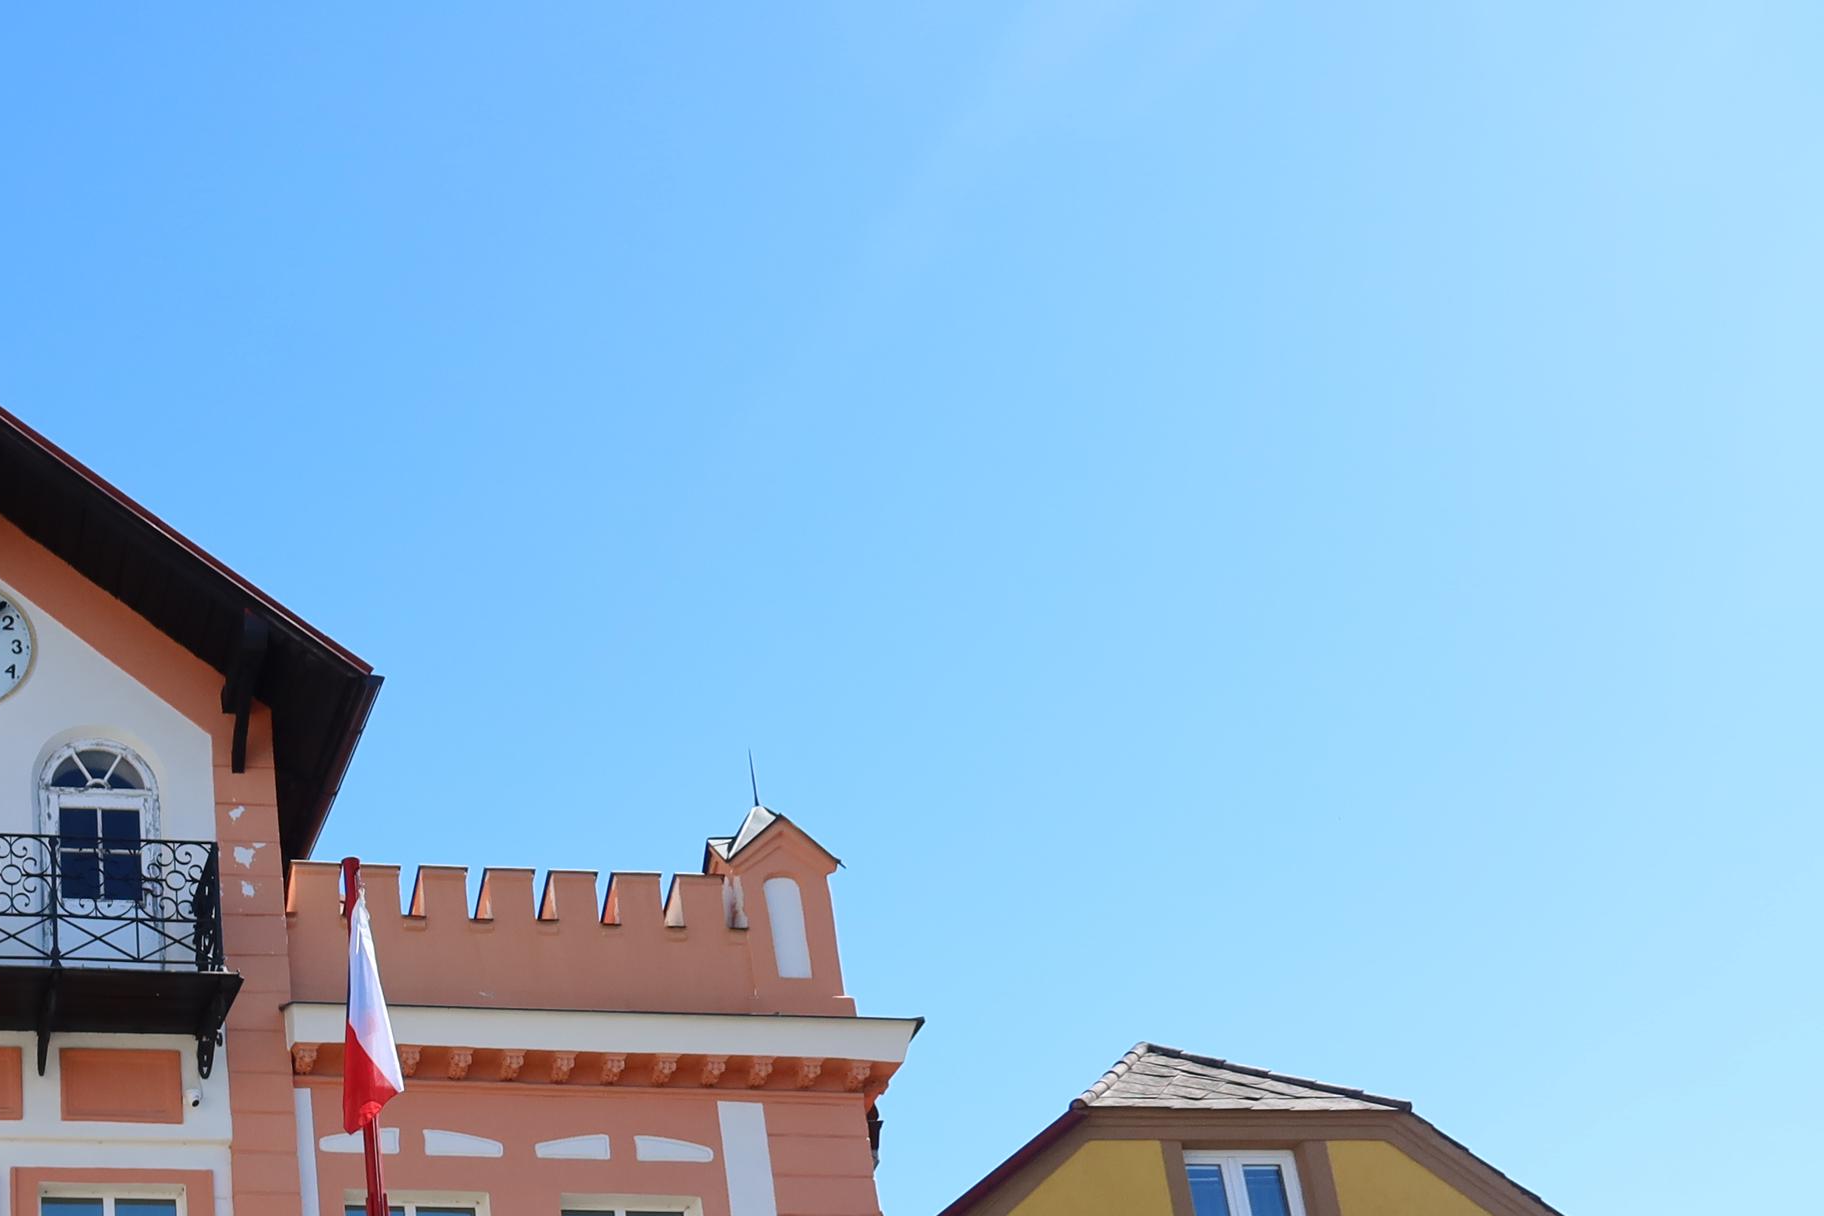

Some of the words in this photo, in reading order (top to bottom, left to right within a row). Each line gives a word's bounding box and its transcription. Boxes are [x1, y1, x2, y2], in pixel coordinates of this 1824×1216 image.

[2, 615, 14, 631] 2
[11, 639, 23, 655] 3
[4, 664, 16, 679] 4
